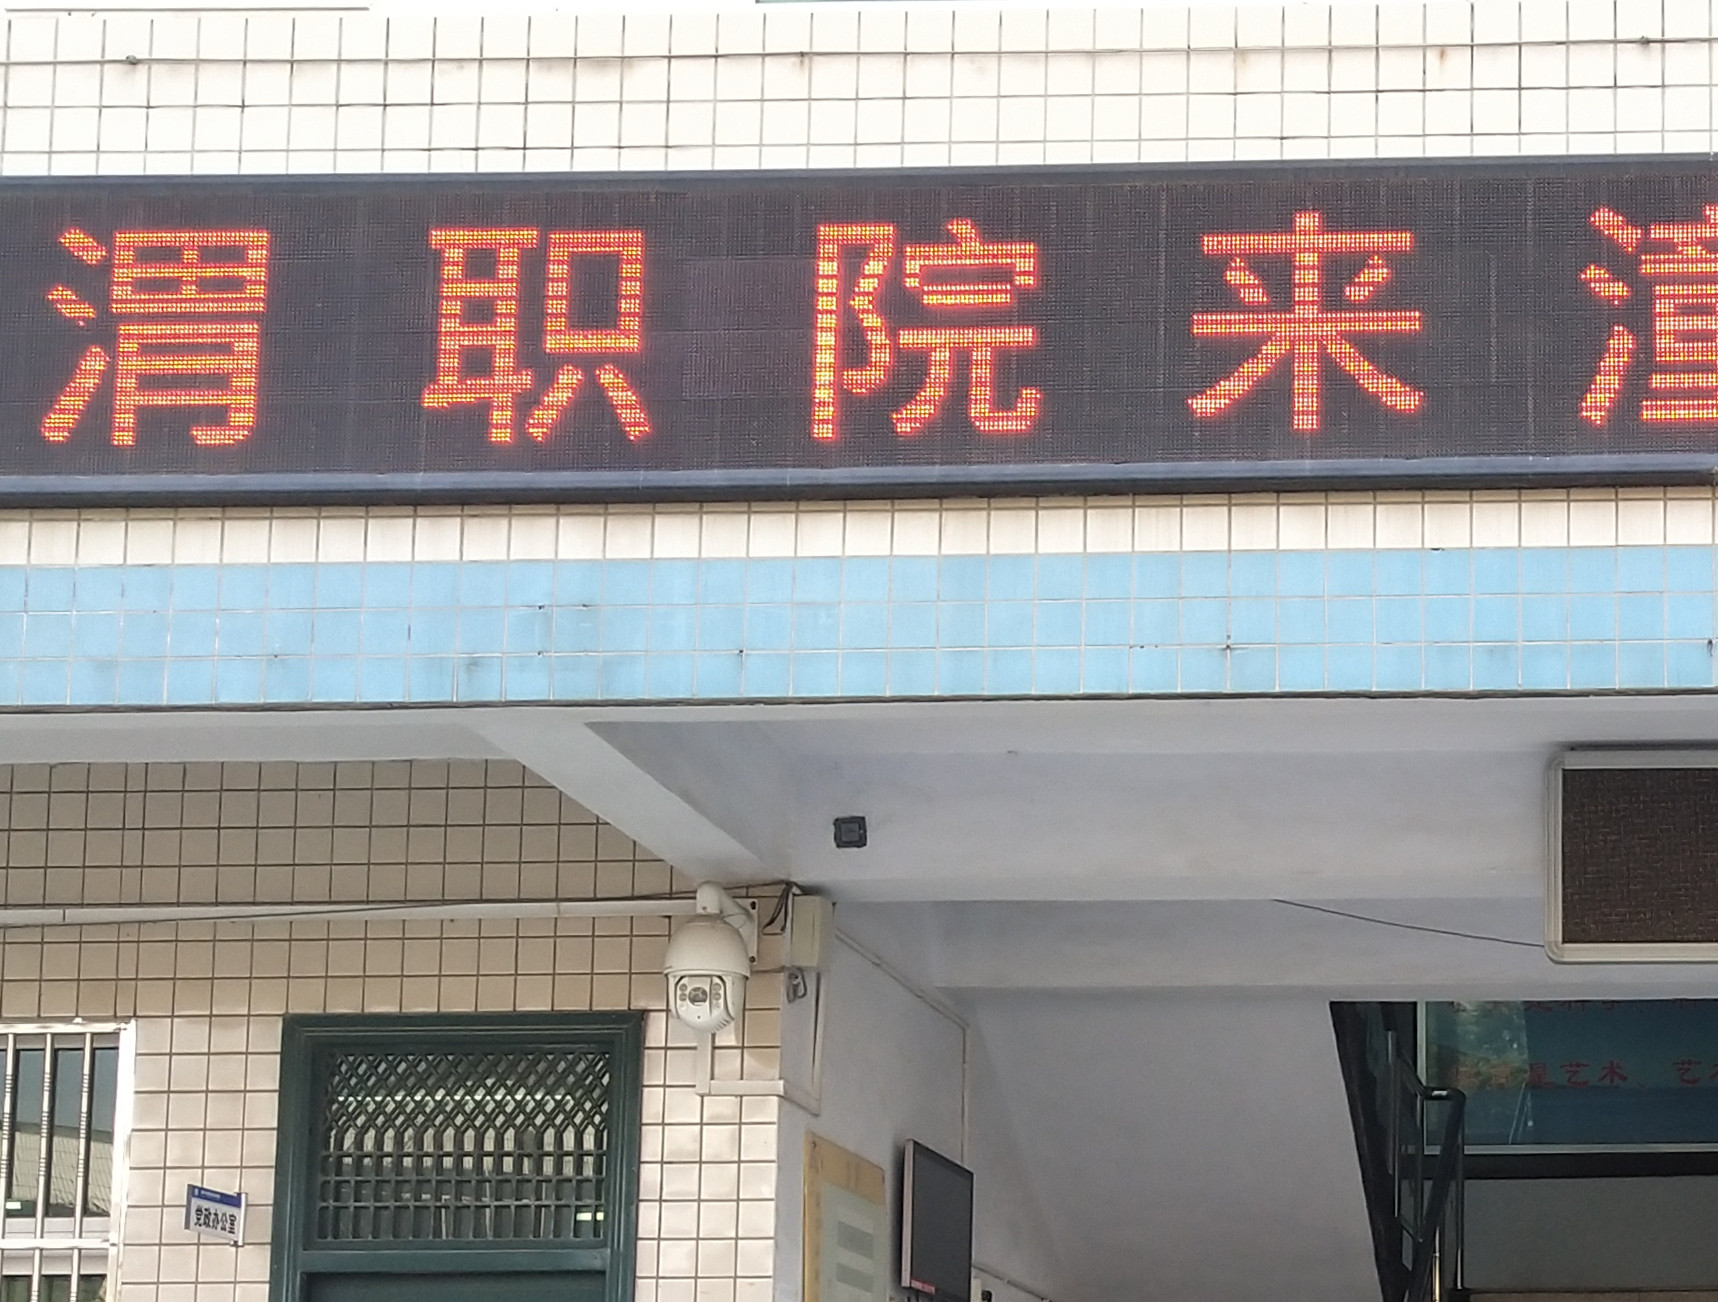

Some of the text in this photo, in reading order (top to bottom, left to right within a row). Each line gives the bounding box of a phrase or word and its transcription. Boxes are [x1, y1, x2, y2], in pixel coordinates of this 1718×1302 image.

[194, 1205, 237, 1235] 党政办公室
